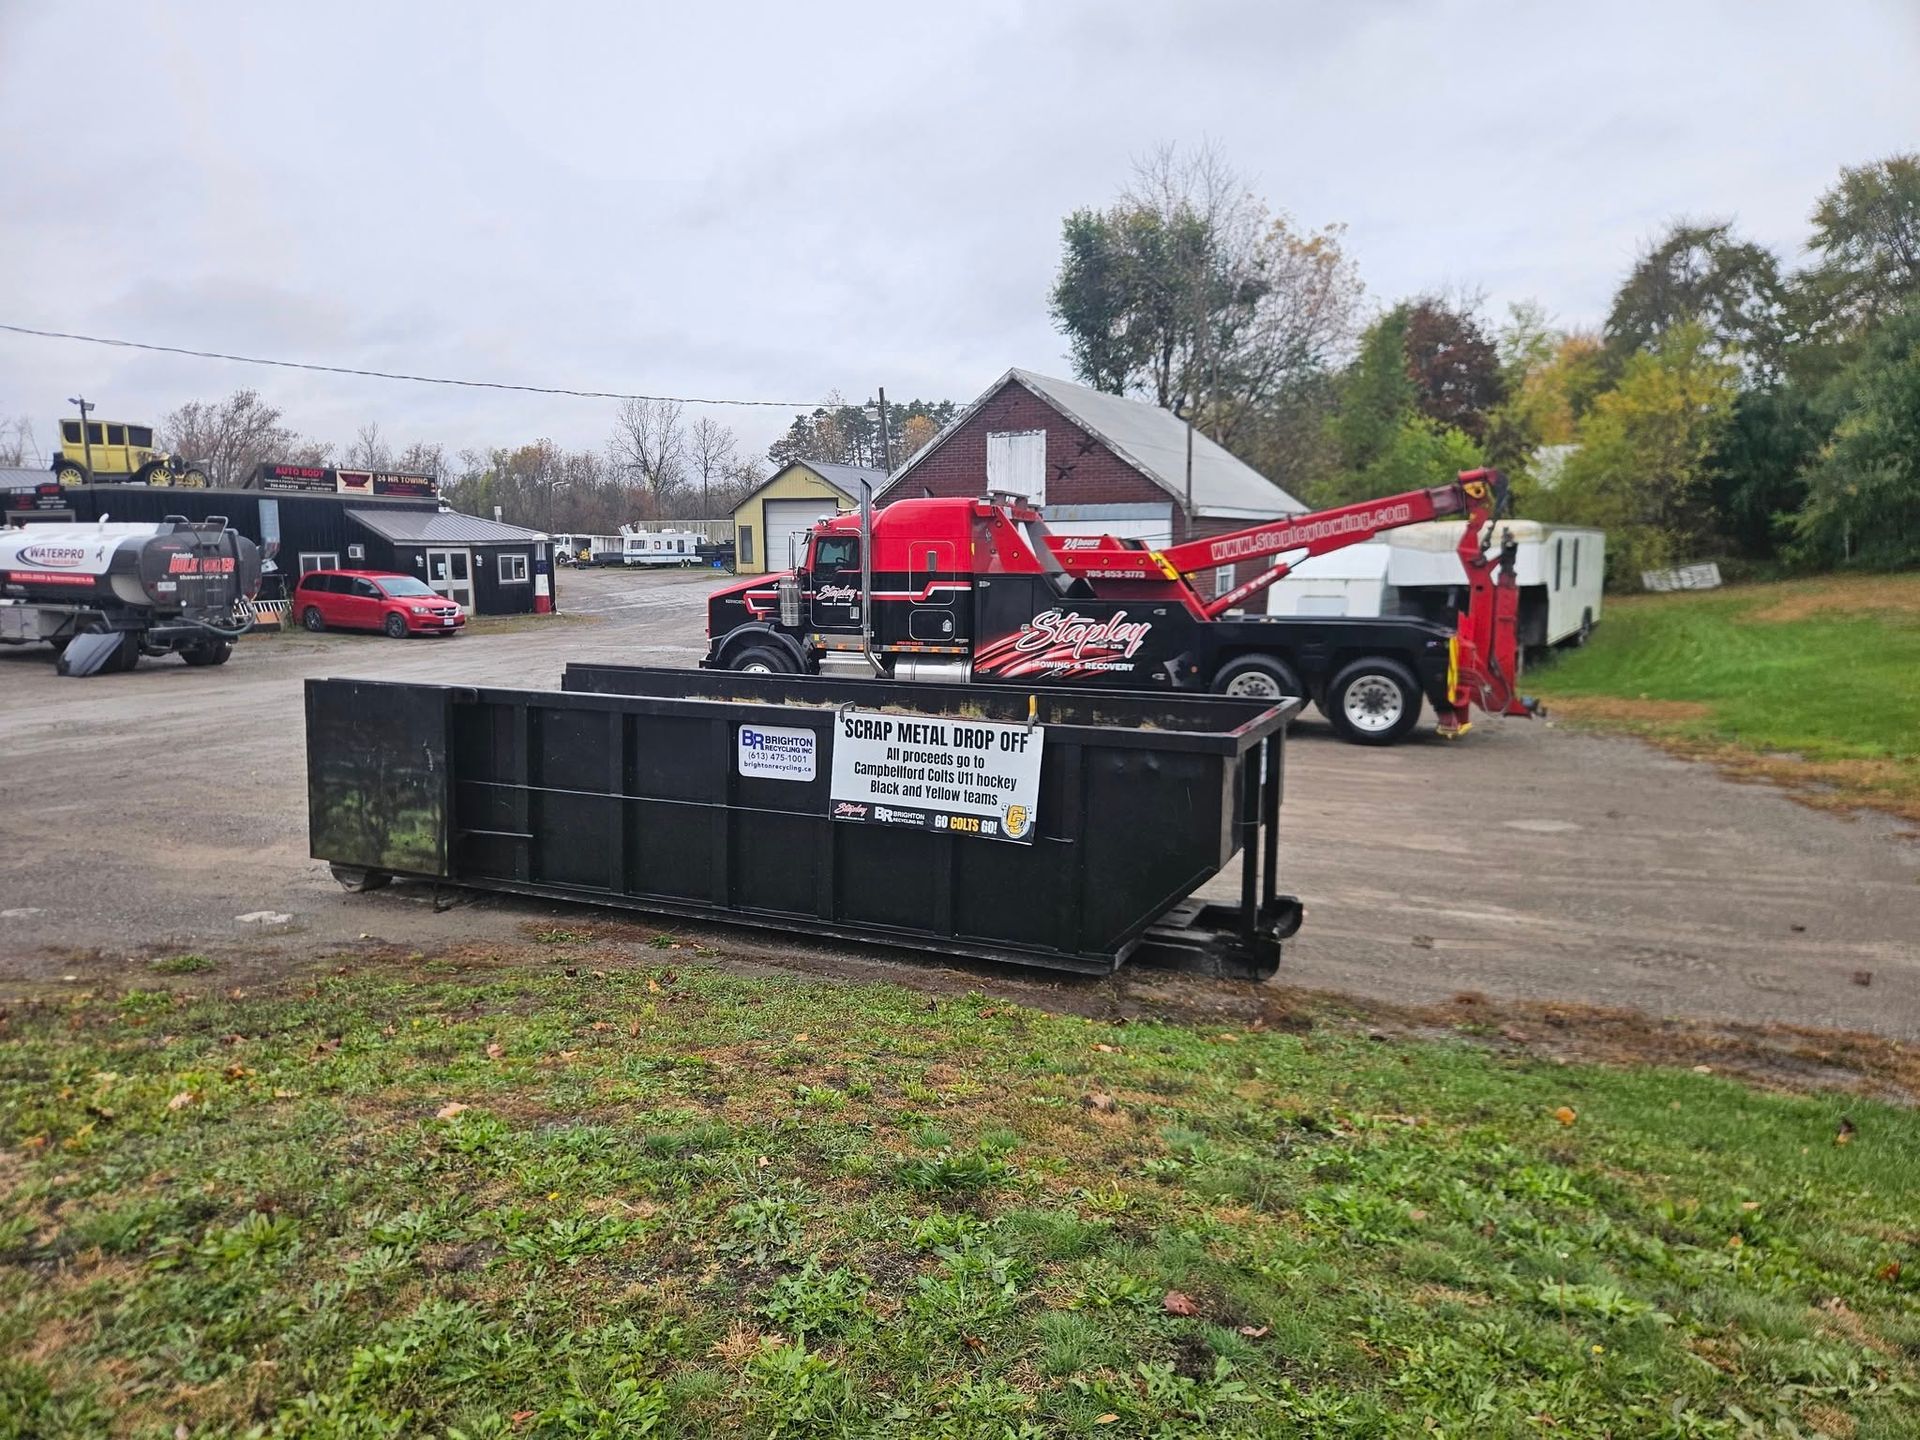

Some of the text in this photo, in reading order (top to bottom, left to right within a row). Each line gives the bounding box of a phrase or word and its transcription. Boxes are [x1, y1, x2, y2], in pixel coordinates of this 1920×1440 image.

[275, 466, 325, 477] AUTO BODY
[376, 474, 386, 482] 24
[387, 475, 399, 483] HR
[401, 476, 428, 485] TOWING
[1062, 538, 1078, 550] 24
[30, 548, 85, 559] WATERPRO
[816, 585, 857, 602] Stapley
[1015, 610, 1152, 659] Stapley
[1033, 660, 1070, 669] TOWING
[1085, 662, 1135, 671] RECOVERY
[742, 729, 765, 751] BR
[765, 735, 813, 747] BRIGHTON
[844, 718, 1029, 753] SCRAP METAL DROP OFF
[764, 744, 813, 755] RECYCLING INC
[748, 751, 807, 763] (613) 475-1001
[887, 747, 985, 769] All proceeds go to
[743, 760, 812, 773] brightonrecycling.ca
[854, 761, 1017, 792] Campbellford Colts U11 hockey
[870, 780, 998, 806] Black and Yellow teams
[893, 811, 925, 820] BRIGHTON
[934, 815, 998, 835] GO COLTS GO!
